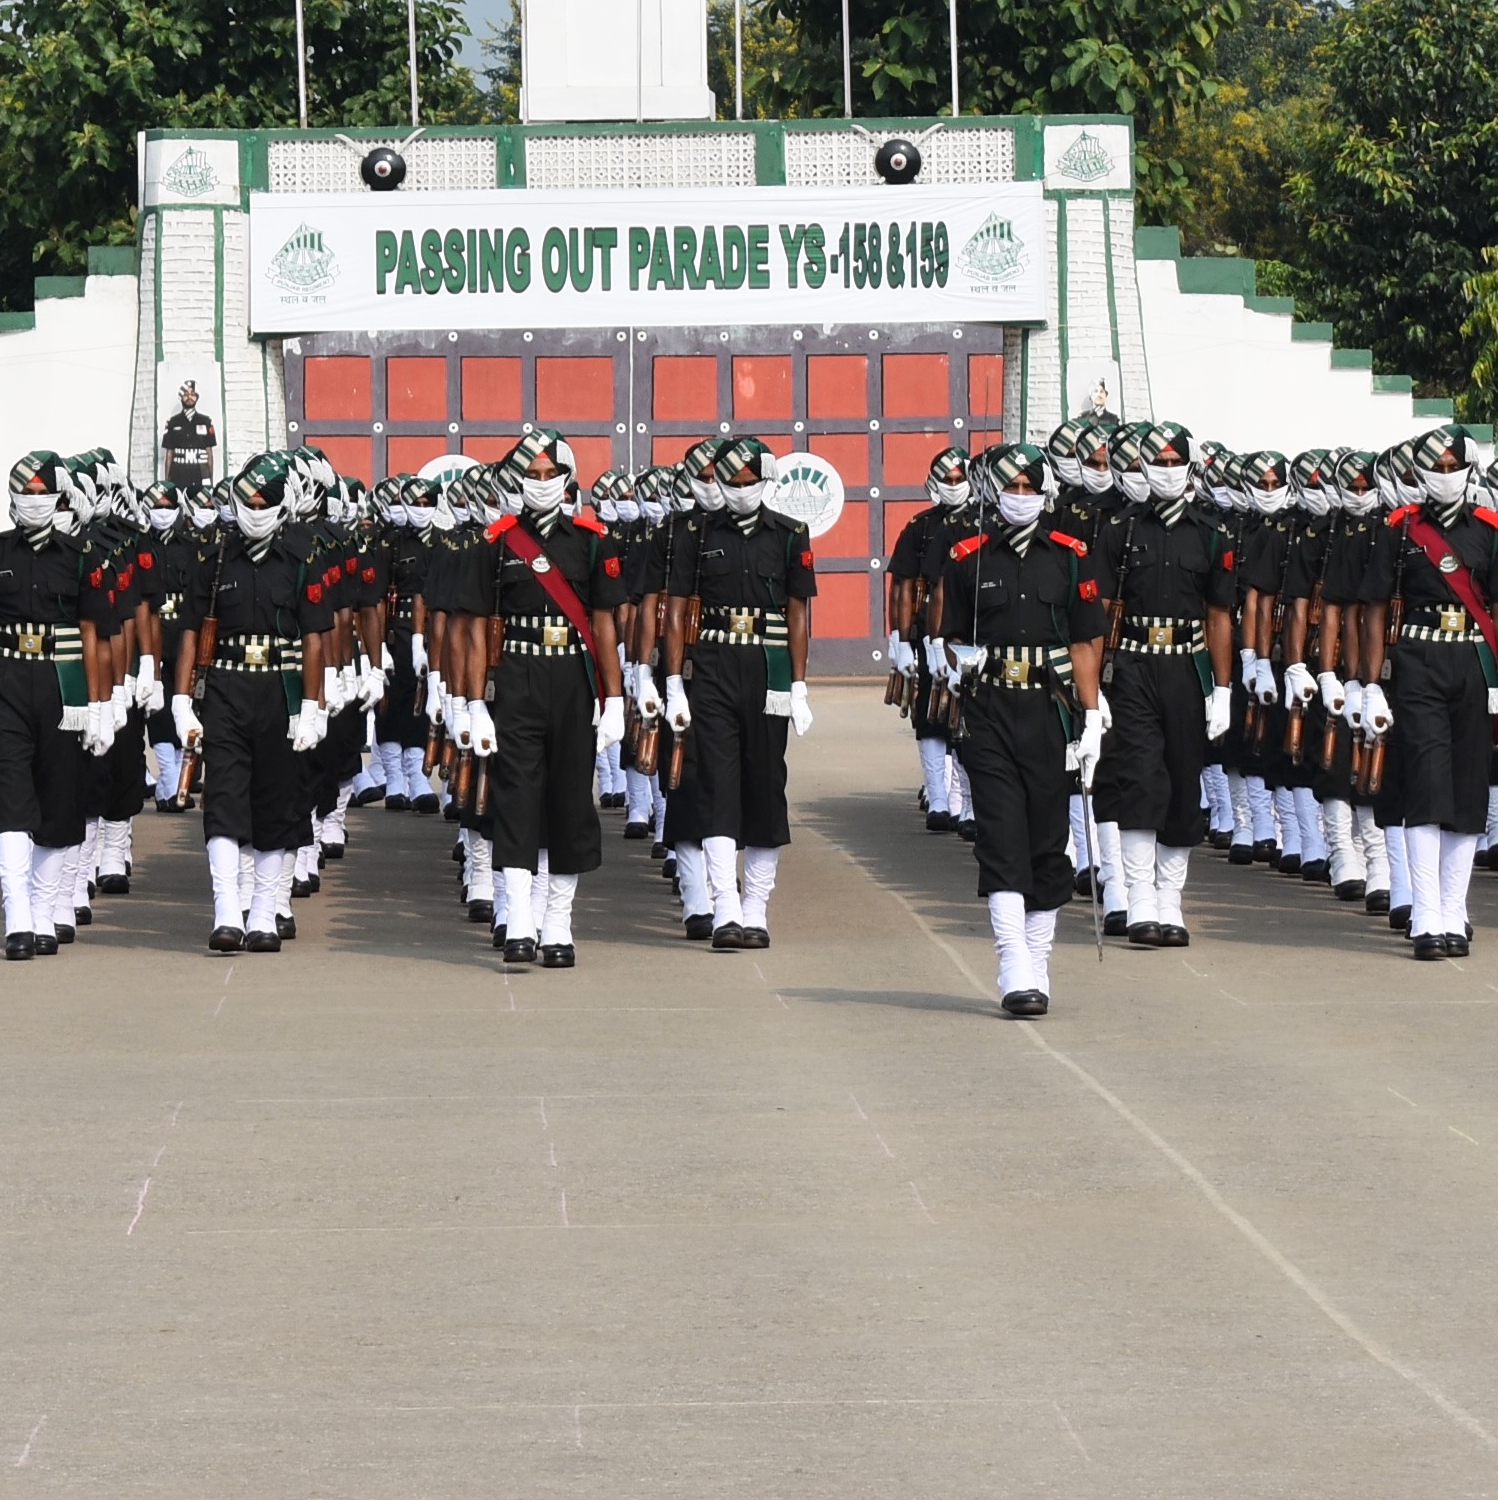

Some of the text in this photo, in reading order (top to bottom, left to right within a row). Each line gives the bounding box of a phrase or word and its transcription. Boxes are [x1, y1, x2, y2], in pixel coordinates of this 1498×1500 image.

[376, 227, 531, 294] PASSING
[542, 227, 618, 293] OUT
[629, 224, 770, 291] PARADE
